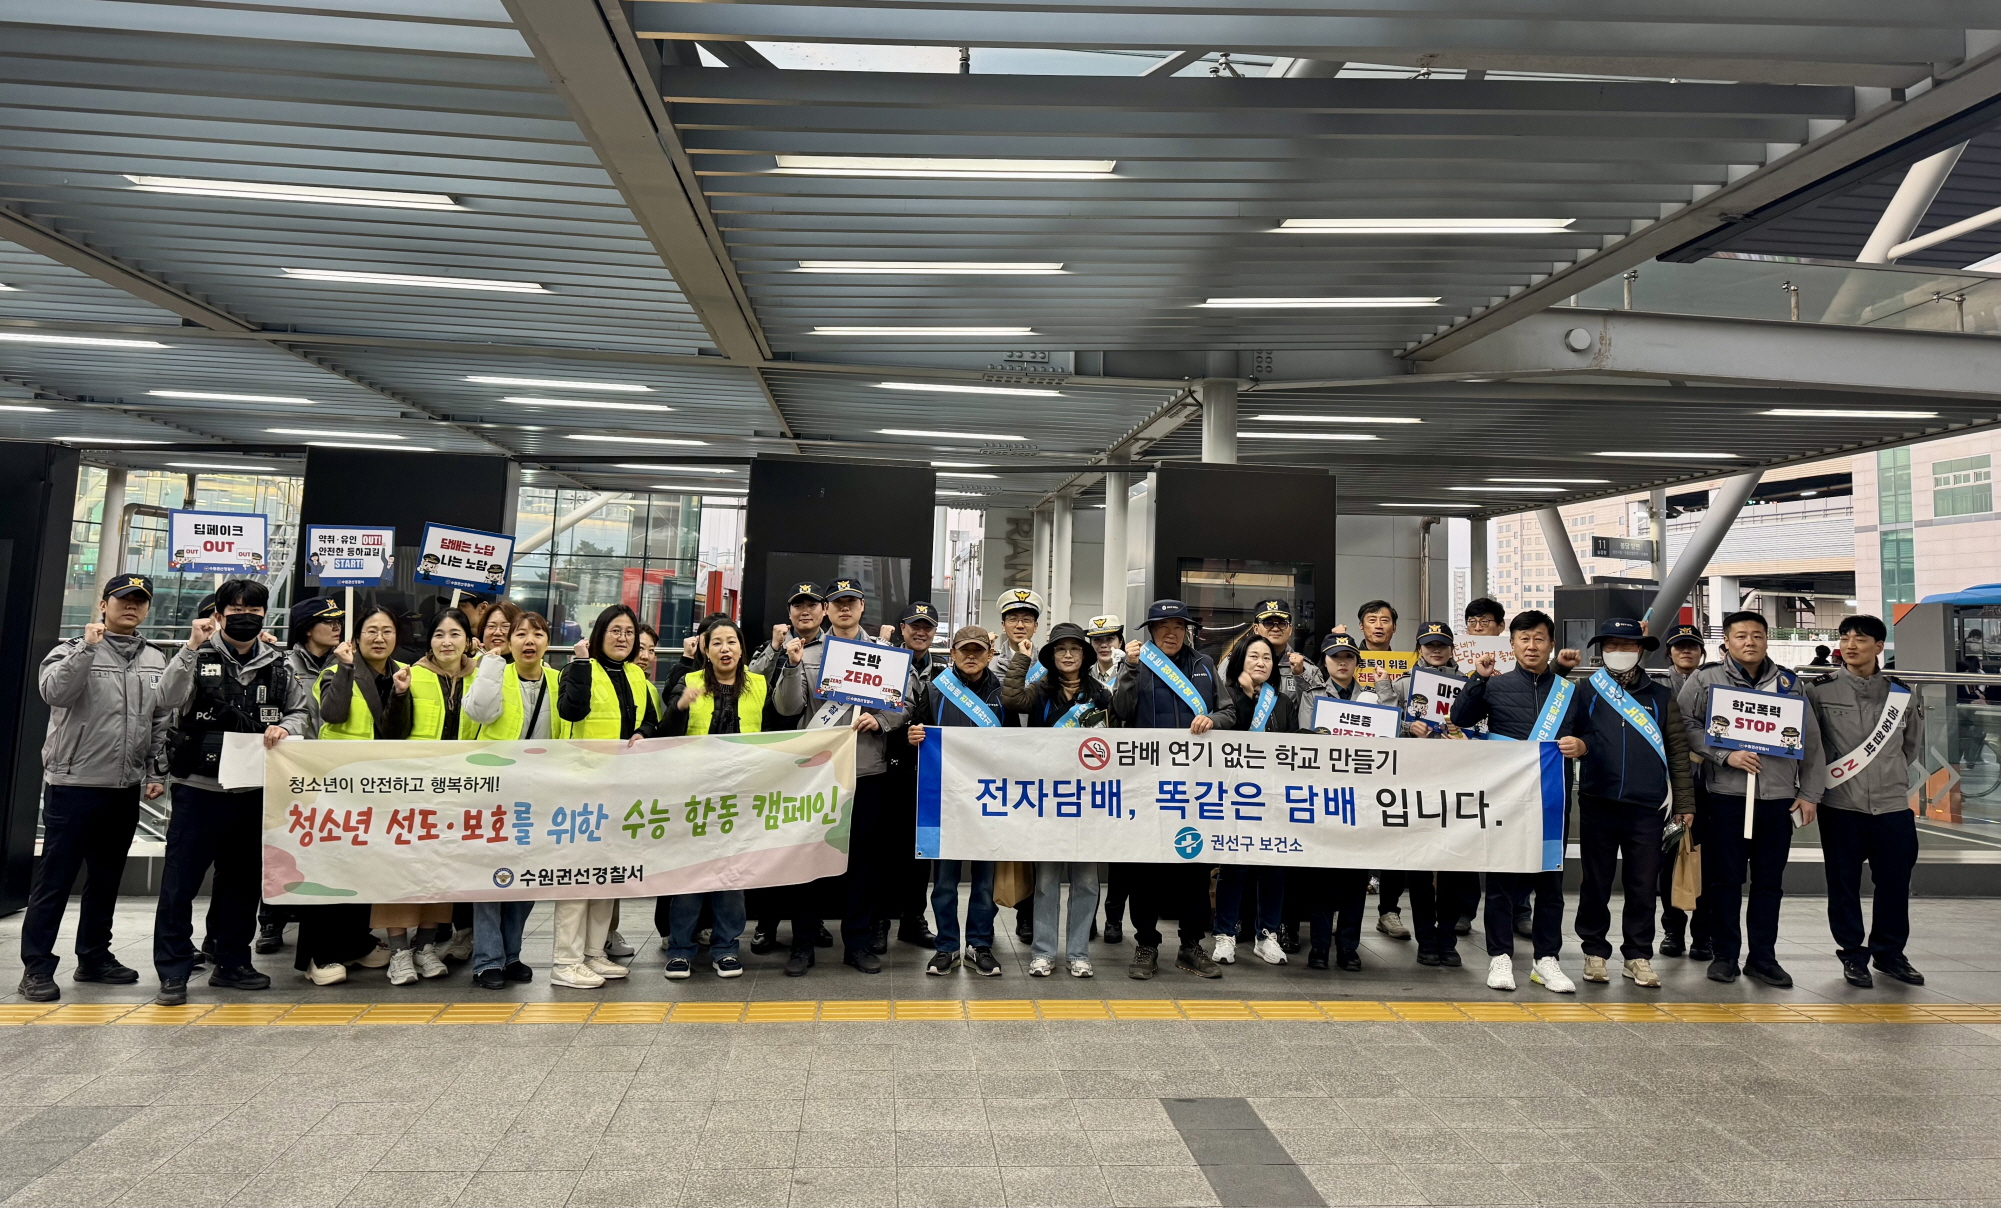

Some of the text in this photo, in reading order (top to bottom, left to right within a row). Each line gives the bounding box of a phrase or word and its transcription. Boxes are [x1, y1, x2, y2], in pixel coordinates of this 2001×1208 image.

[194, 523, 243, 536] 딥페이크
[203, 540, 235, 553] OUT
[362, 535, 382, 545] OUT!
[440, 537, 496, 557] 담배는 노담
[1598, 539, 1606, 550] 11
[318, 546, 380, 557] 안전한 등하교길
[335, 558, 363, 569] START!
[440, 554, 488, 572] 나는 노담
[852, 651, 882, 670] 도박
[1388, 659, 1408, 670] 위험
[829, 677, 842, 685] ZERO
[843, 669, 883, 687] ZERO
[1731, 699, 1782, 718] 학교폭력
[1339, 712, 1372, 728] 신분증
[1734, 717, 1777, 734] STOP
[1116, 740, 1398, 776] 담배 연기 없는 학교 만들기
[1830, 758, 1860, 780] NO
[288, 776, 500, 794] 청소년이 안전하고 행복하게!
[975, 777, 1503, 829] 전자담배, 똑같은 담배 입니다.
[288, 803, 373, 848] 청소년
[547, 803, 609, 845] 위한
[621, 798, 671, 840] 수능
[684, 794, 739, 836] 합동
[752, 785, 839, 831] 캠페인
[1211, 834, 1304, 854] 권선구 보건소
[519, 864, 644, 887] 수원권선경찰서
